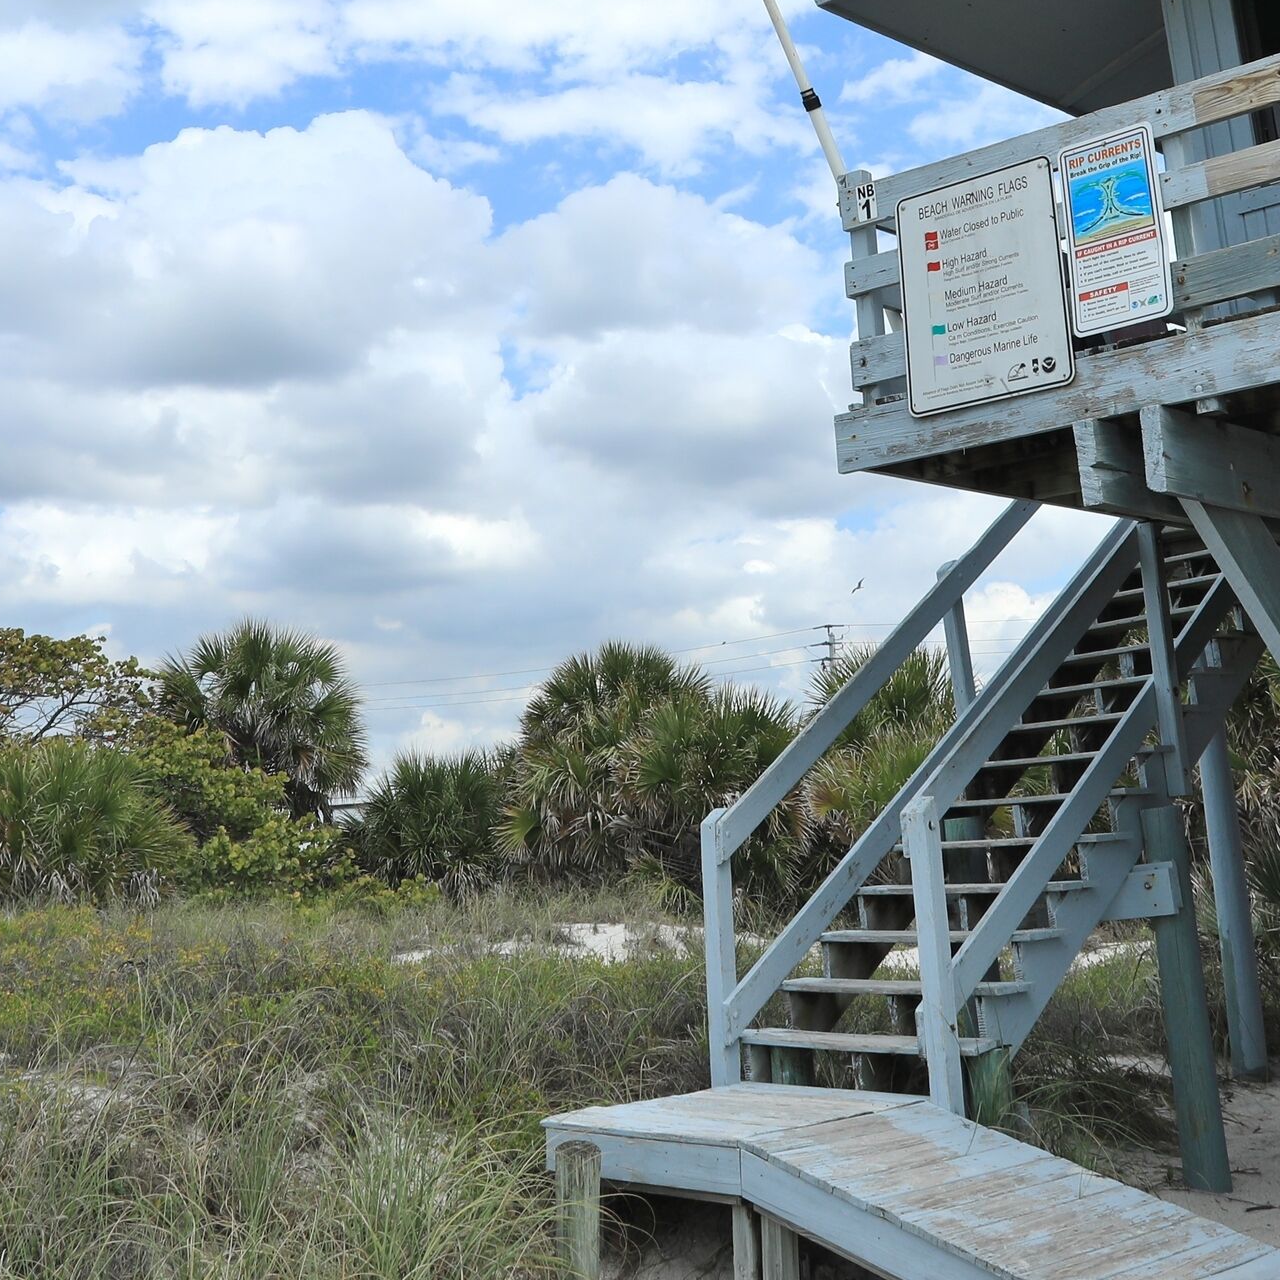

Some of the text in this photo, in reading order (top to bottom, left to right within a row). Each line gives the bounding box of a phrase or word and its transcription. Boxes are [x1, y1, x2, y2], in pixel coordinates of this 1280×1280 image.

[1069, 139, 1141, 170] RIP CURRENTS
[1070, 169, 1087, 178] Break
[1099, 161, 1110, 170] Grip
[857, 184, 874, 200] NB
[918, 176, 1028, 220] BEACH WARNING FLAGS
[862, 199, 871, 219] 1
[940, 226, 962, 240] Water
[964, 218, 989, 234] Closed
[991, 216, 998, 225] to
[1000, 208, 1024, 222] Public
[1084, 245, 1105, 255] CAUGHT
[1129, 232, 1154, 243] CURRENT
[942, 248, 987, 270] High Hazard
[943, 268, 954, 278] High
[955, 264, 965, 273] Surf
[982, 256, 998, 267] Strong
[999, 252, 1019, 262] Currents
[944, 285, 976, 301] Medium
[978, 275, 1008, 292] Hazard
[971, 292, 982, 302] Surf
[1001, 282, 1024, 292] Currents
[1089, 286, 1117, 298] SAFETY
[947, 312, 997, 332] Low Hazard
[948, 333, 962, 342] Cam
[950, 346, 992, 364] Dangerous
[994, 339, 1021, 352] Marine
[1023, 334, 1038, 345] Life
